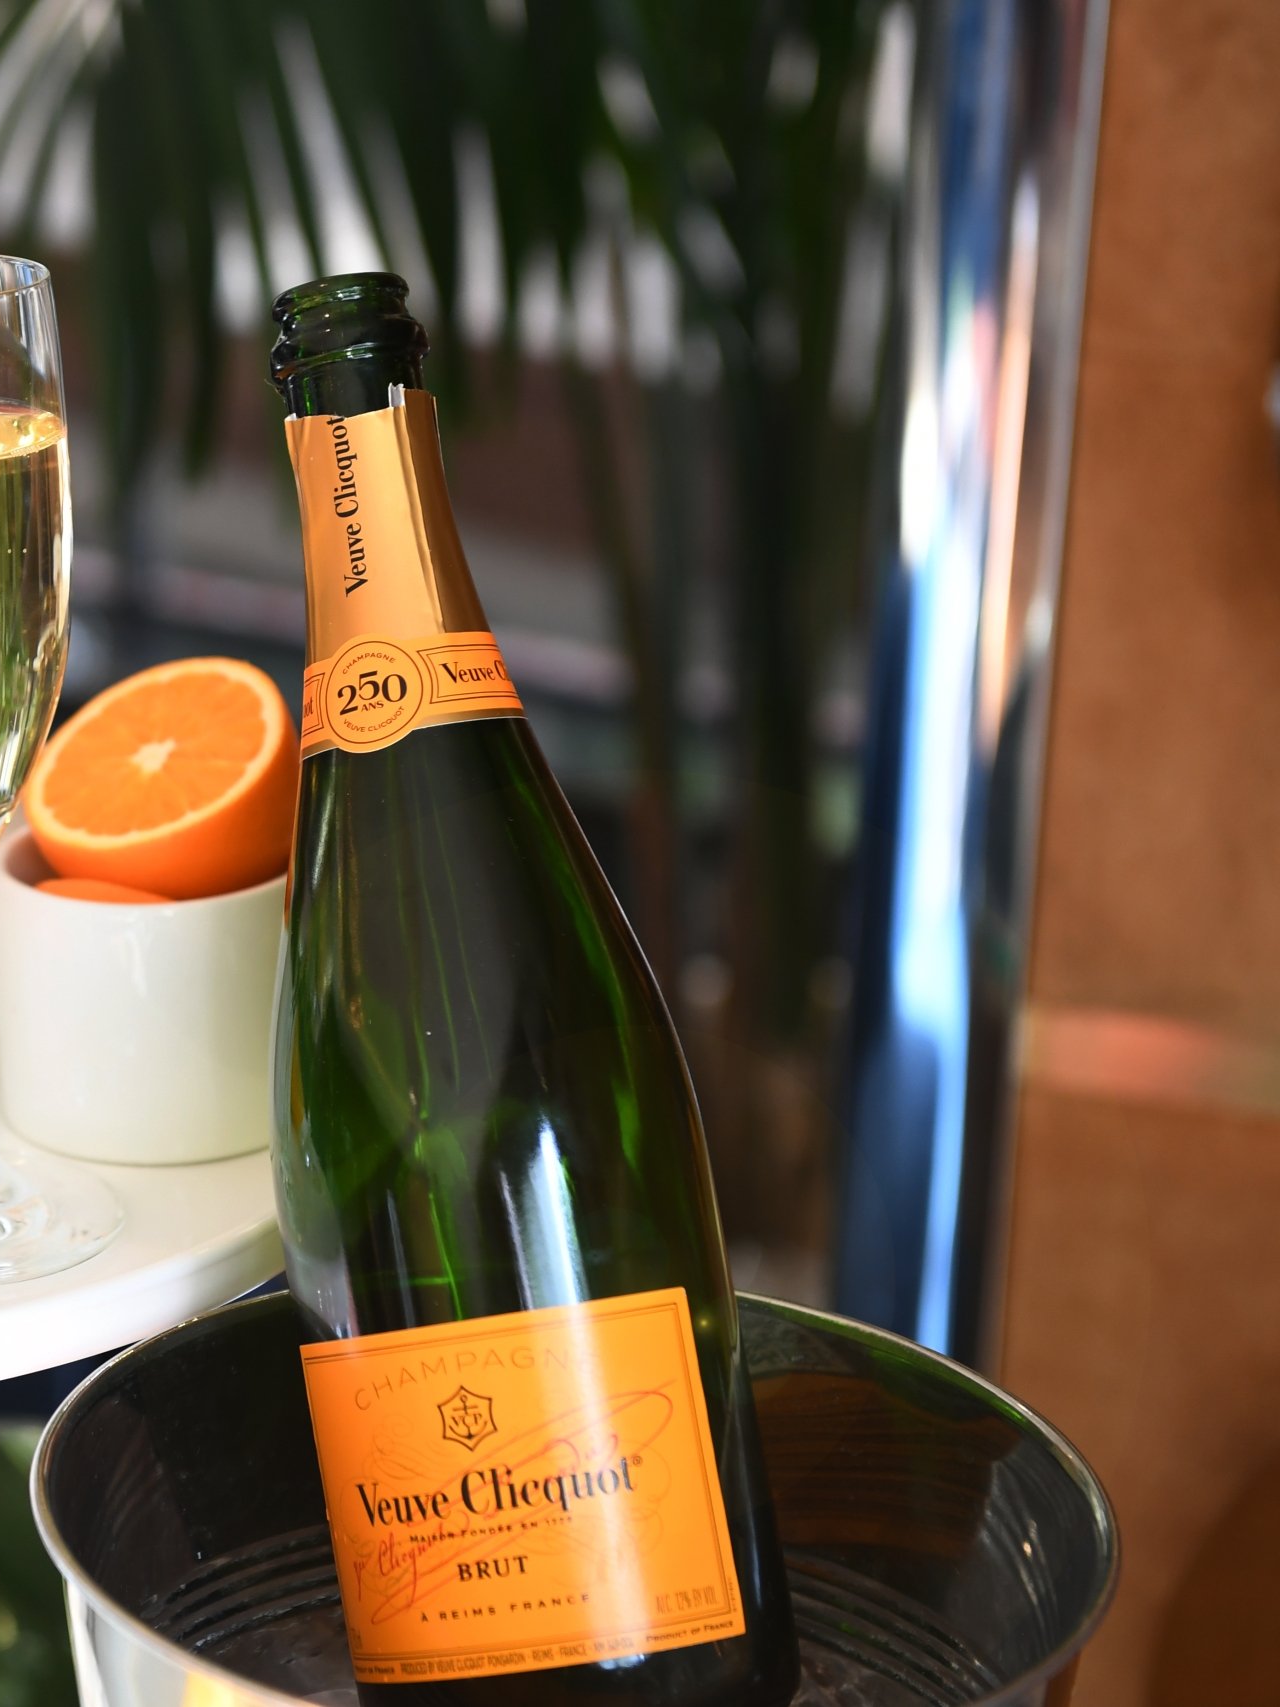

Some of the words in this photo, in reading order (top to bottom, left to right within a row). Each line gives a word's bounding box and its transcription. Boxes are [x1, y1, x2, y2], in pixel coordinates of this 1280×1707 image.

[326, 415, 359, 518] Clicquot
[344, 522, 368, 597] Veuve
[342, 652, 396, 675] CHAMPAGNE
[439, 661, 496, 684] Veuve
[337, 670, 407, 716] 250
[361, 701, 385, 713] ANS
[343, 719, 366, 733] VEUVE
[367, 705, 405, 732] CLICQUOT
[354, 1345, 599, 1411] CHAMPAGN
[355, 1481, 451, 1528] Veuve
[457, 1555, 529, 1583] BRUT
[439, 1606, 496, 1621] REIMS
[510, 1593, 590, 1613] FRANCE
